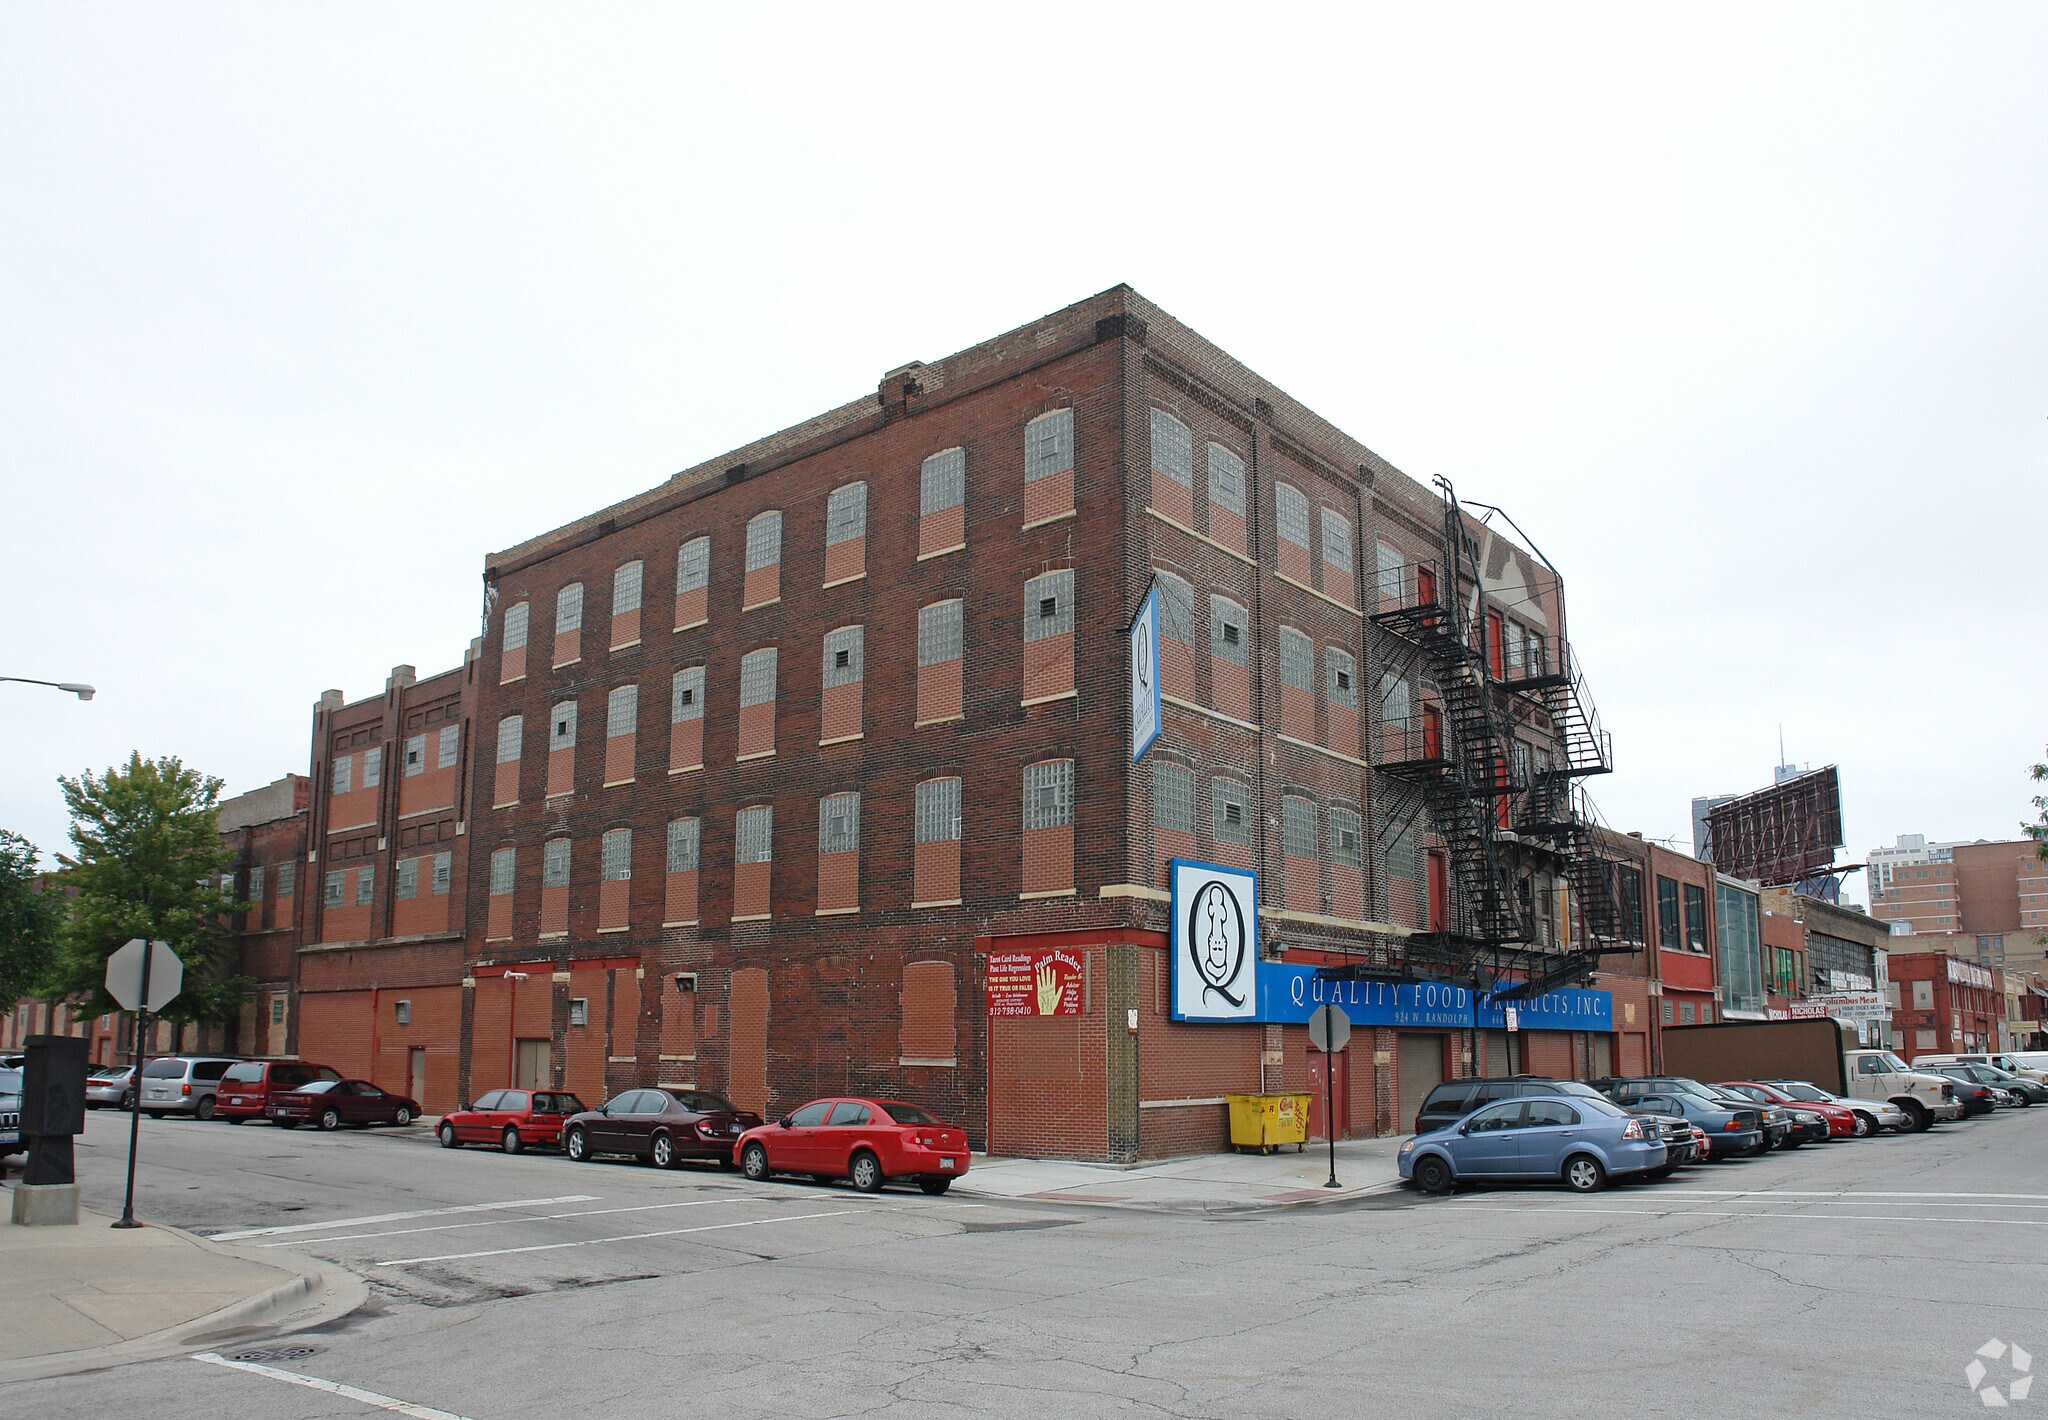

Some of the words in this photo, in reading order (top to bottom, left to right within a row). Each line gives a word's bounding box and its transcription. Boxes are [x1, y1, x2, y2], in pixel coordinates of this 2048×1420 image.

[1034, 955, 1053, 974] Palm
[1055, 950, 1082, 973] Reader
[1290, 975, 1402, 1007] QUALITY
[1414, 984, 1467, 1009] FOOD
[1859, 996, 1878, 1004] Meat
[1792, 1007, 1825, 1016] NICHOLAS
[1394, 1012, 1409, 1023] 924
[1412, 1012, 1423, 1024] W.
[1425, 1013, 1469, 1025] RANDOLPH
